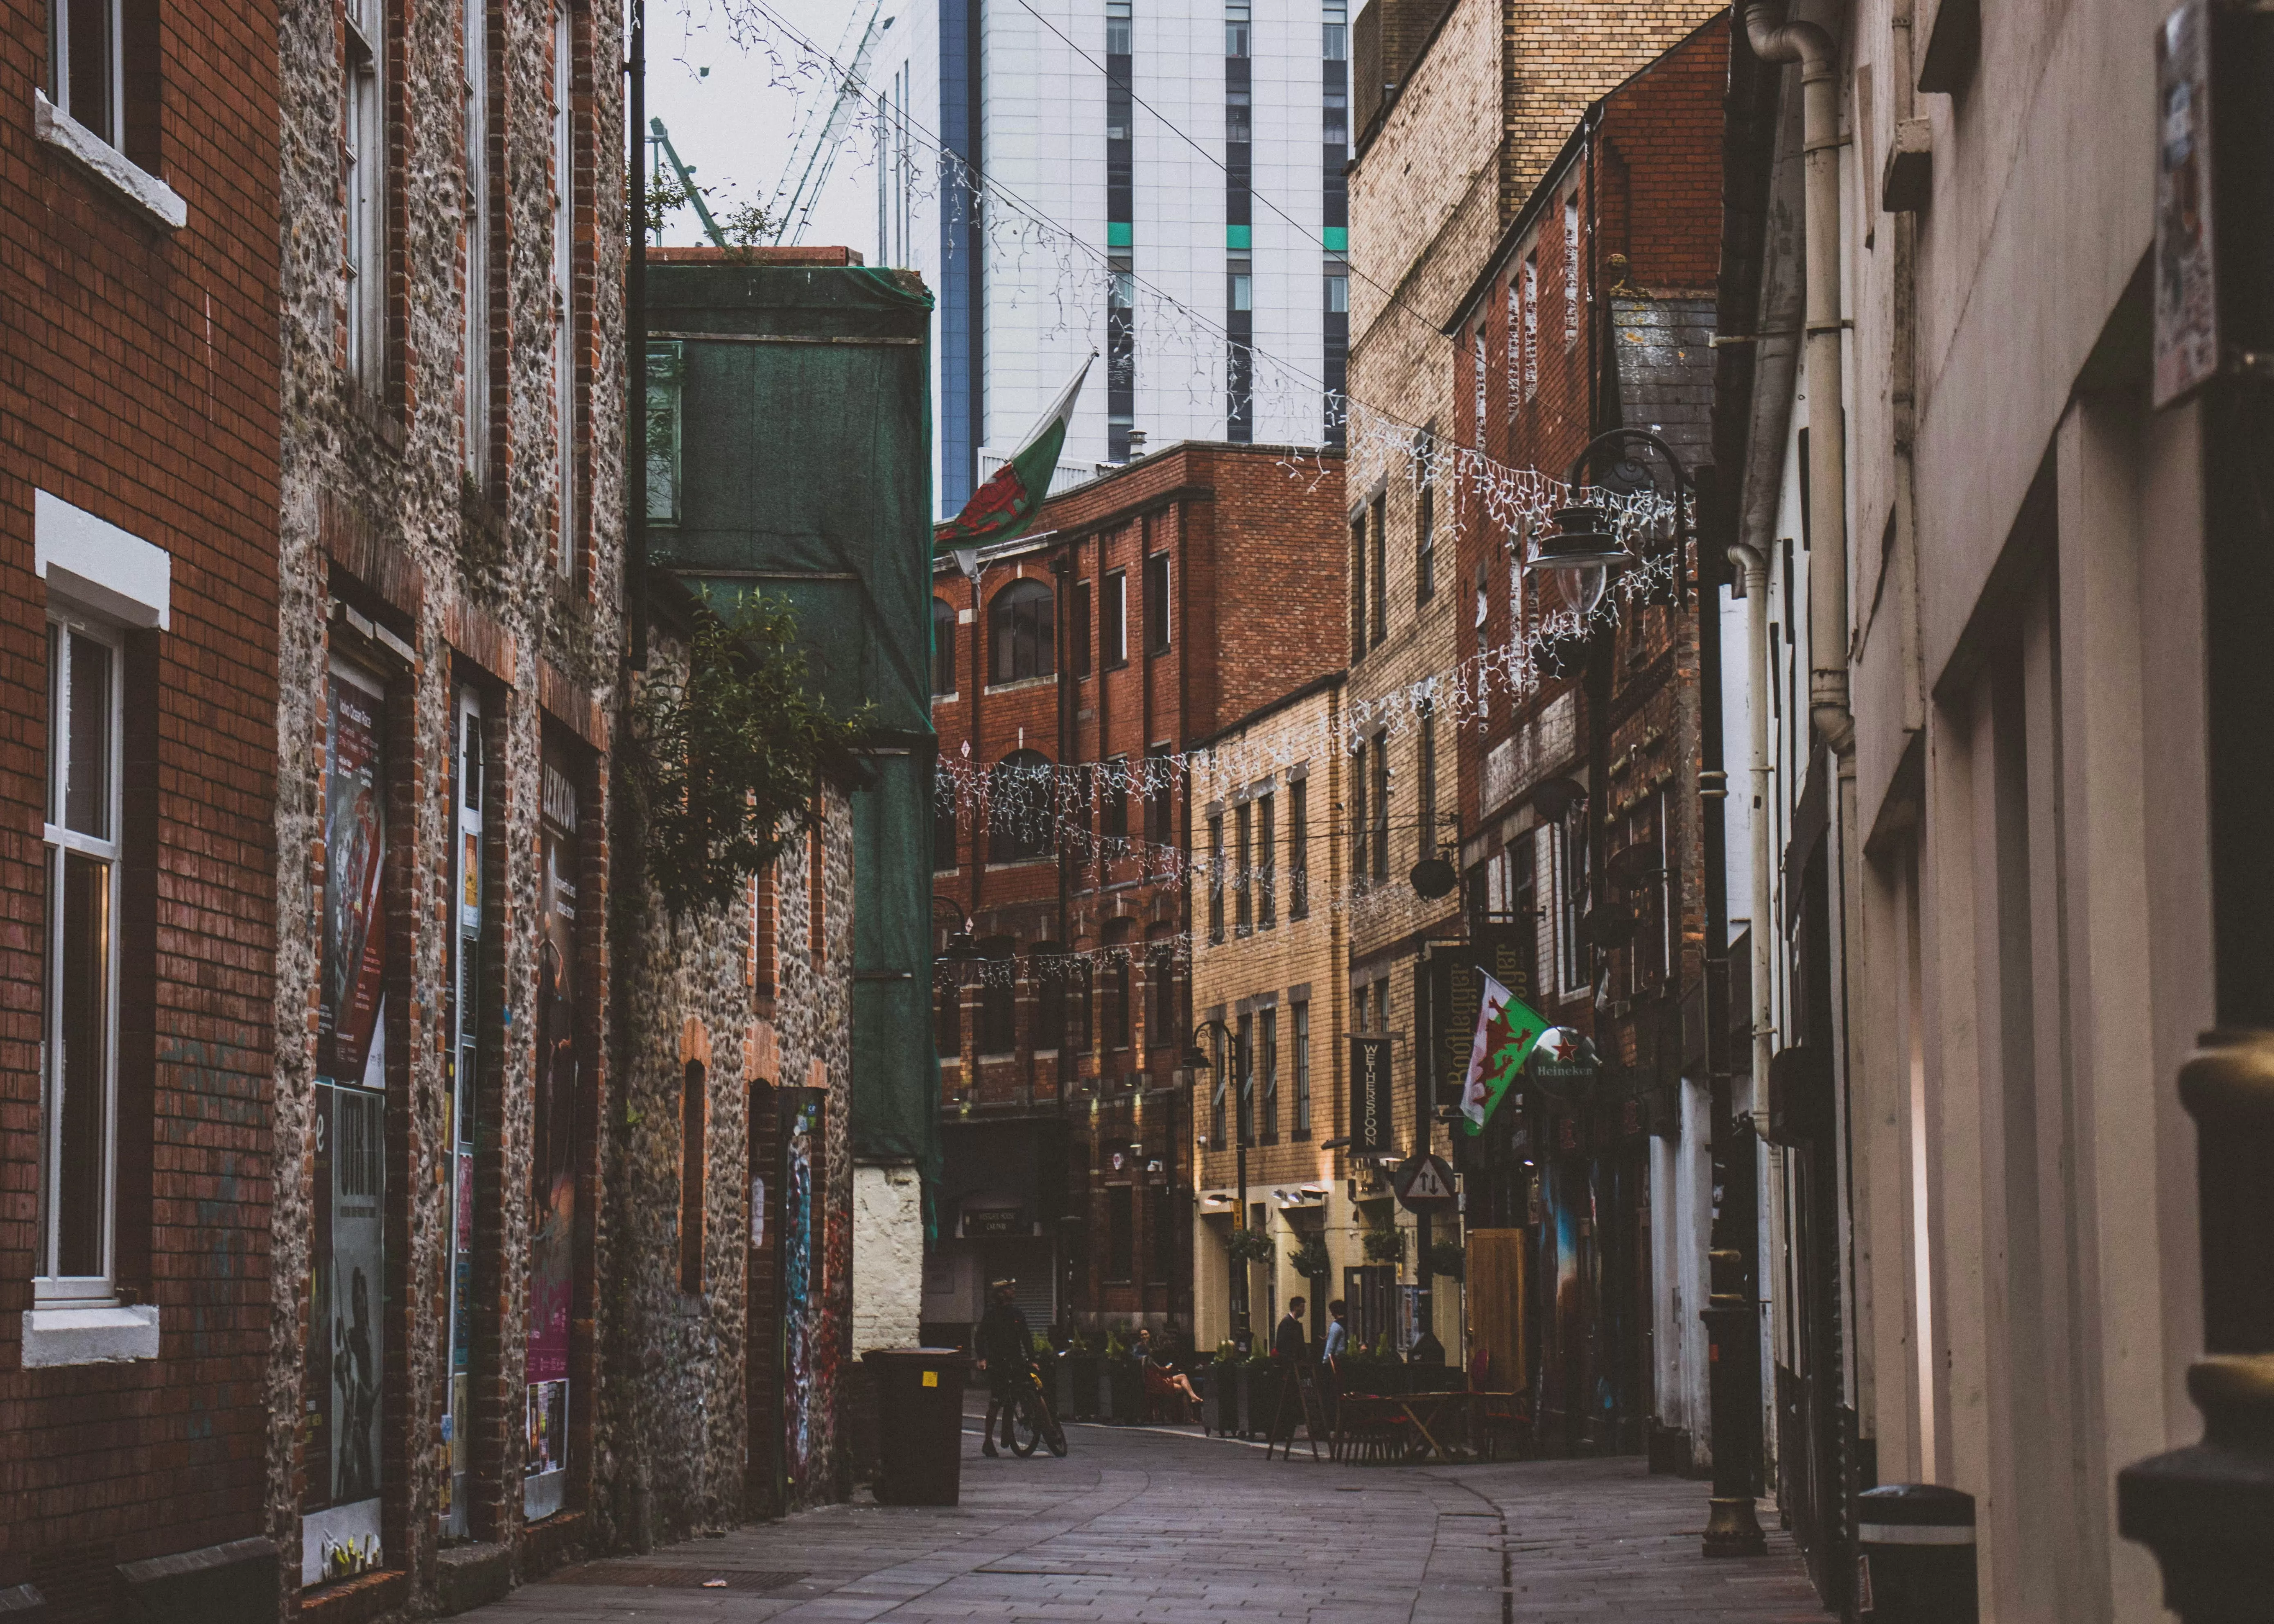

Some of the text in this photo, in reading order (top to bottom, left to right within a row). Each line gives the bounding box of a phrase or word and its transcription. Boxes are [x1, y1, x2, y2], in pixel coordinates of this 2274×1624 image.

[543, 763, 576, 834] LEXICON
[1363, 1044, 1378, 1146] WETHERSPOON
[1538, 1066, 1592, 1076] Heineken
